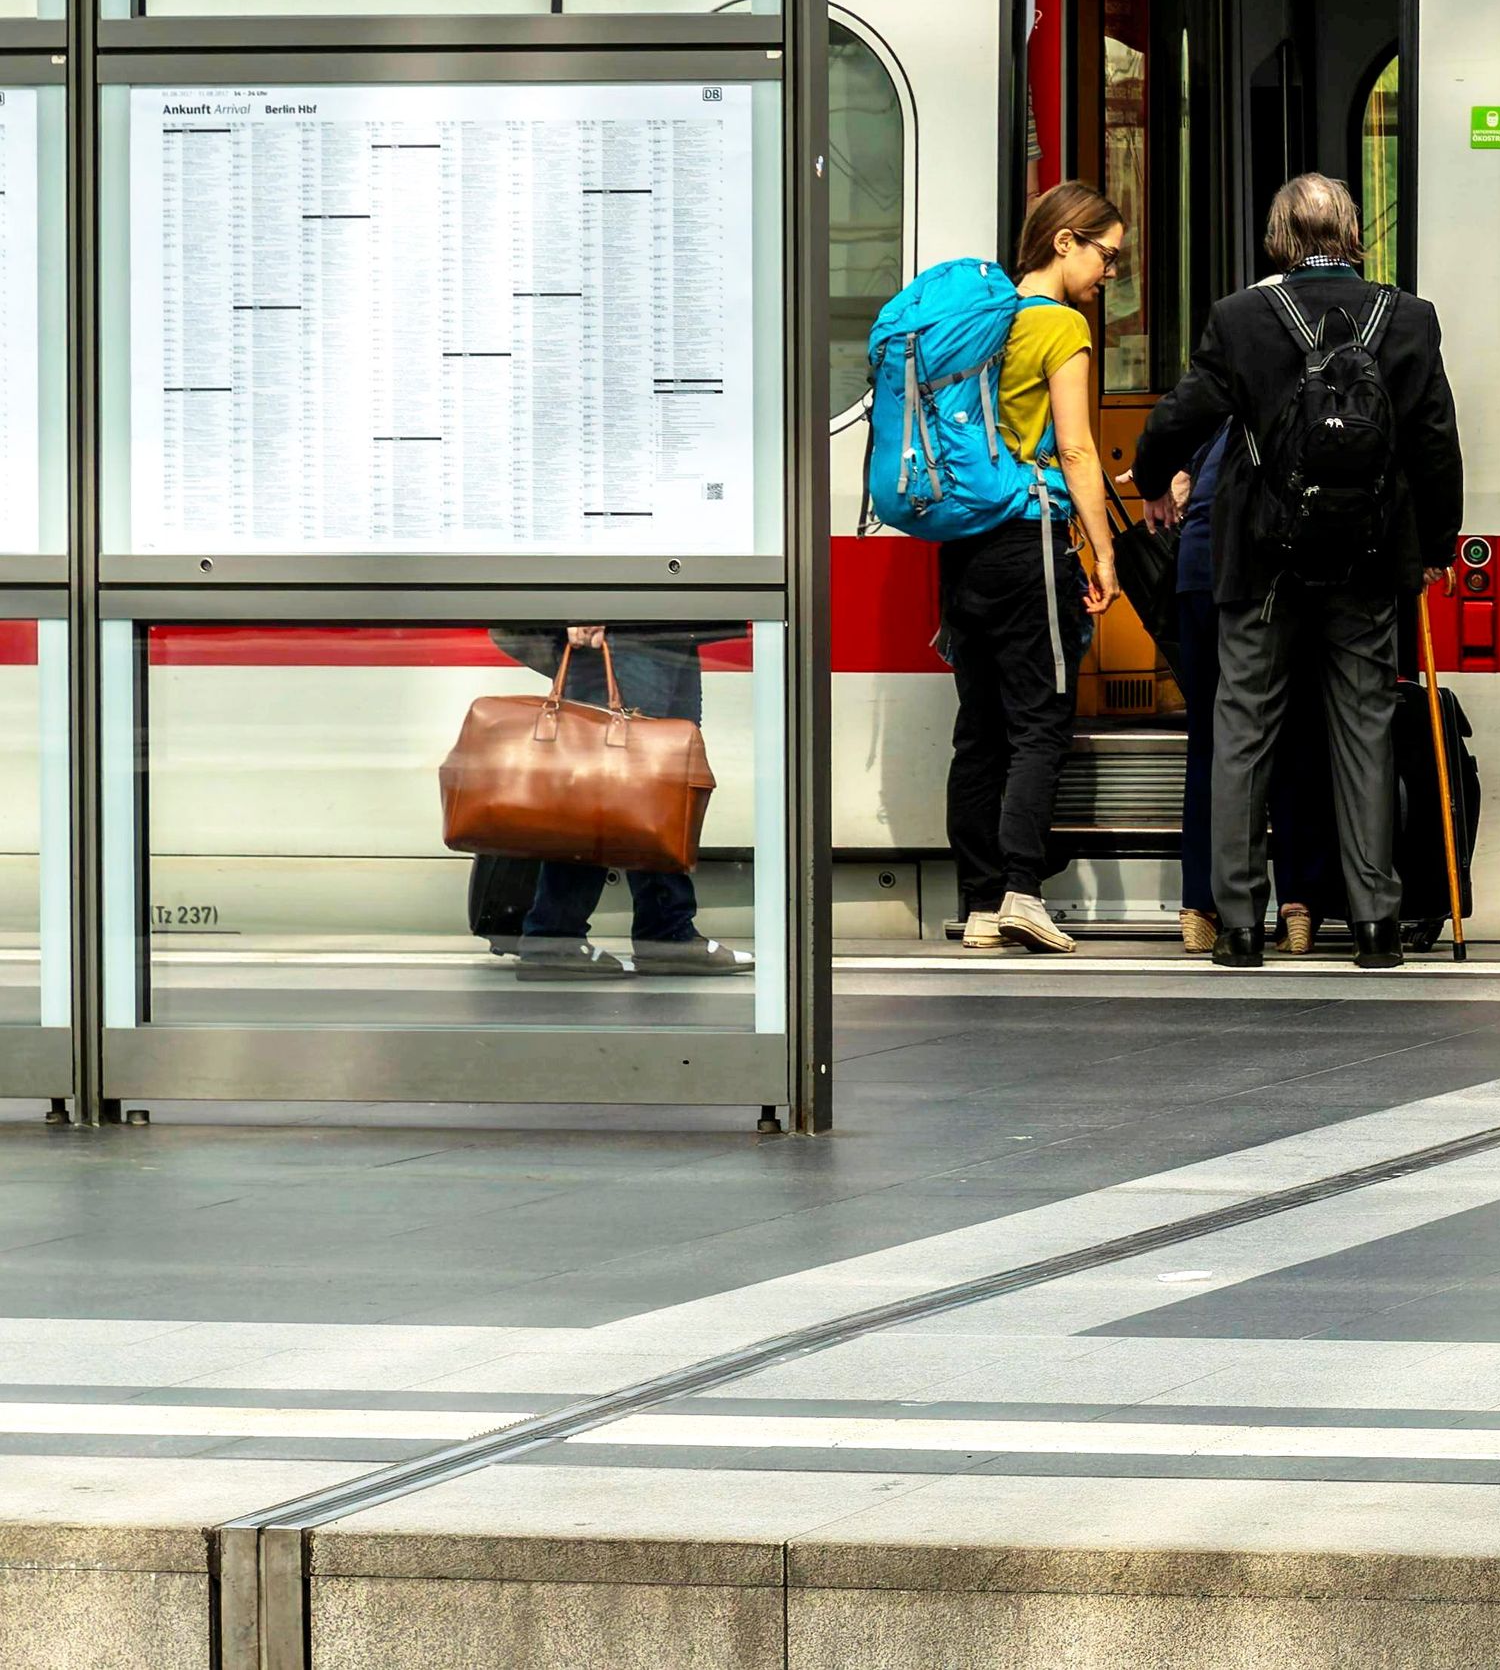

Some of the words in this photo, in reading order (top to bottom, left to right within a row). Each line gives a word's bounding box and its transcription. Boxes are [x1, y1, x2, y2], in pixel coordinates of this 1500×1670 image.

[163, 104, 211, 114] Ankunft
[214, 104, 251, 114] Arrival
[265, 105, 295, 114] Berlin
[298, 105, 317, 114] Hbf
[178, 906, 218, 924] 237)
